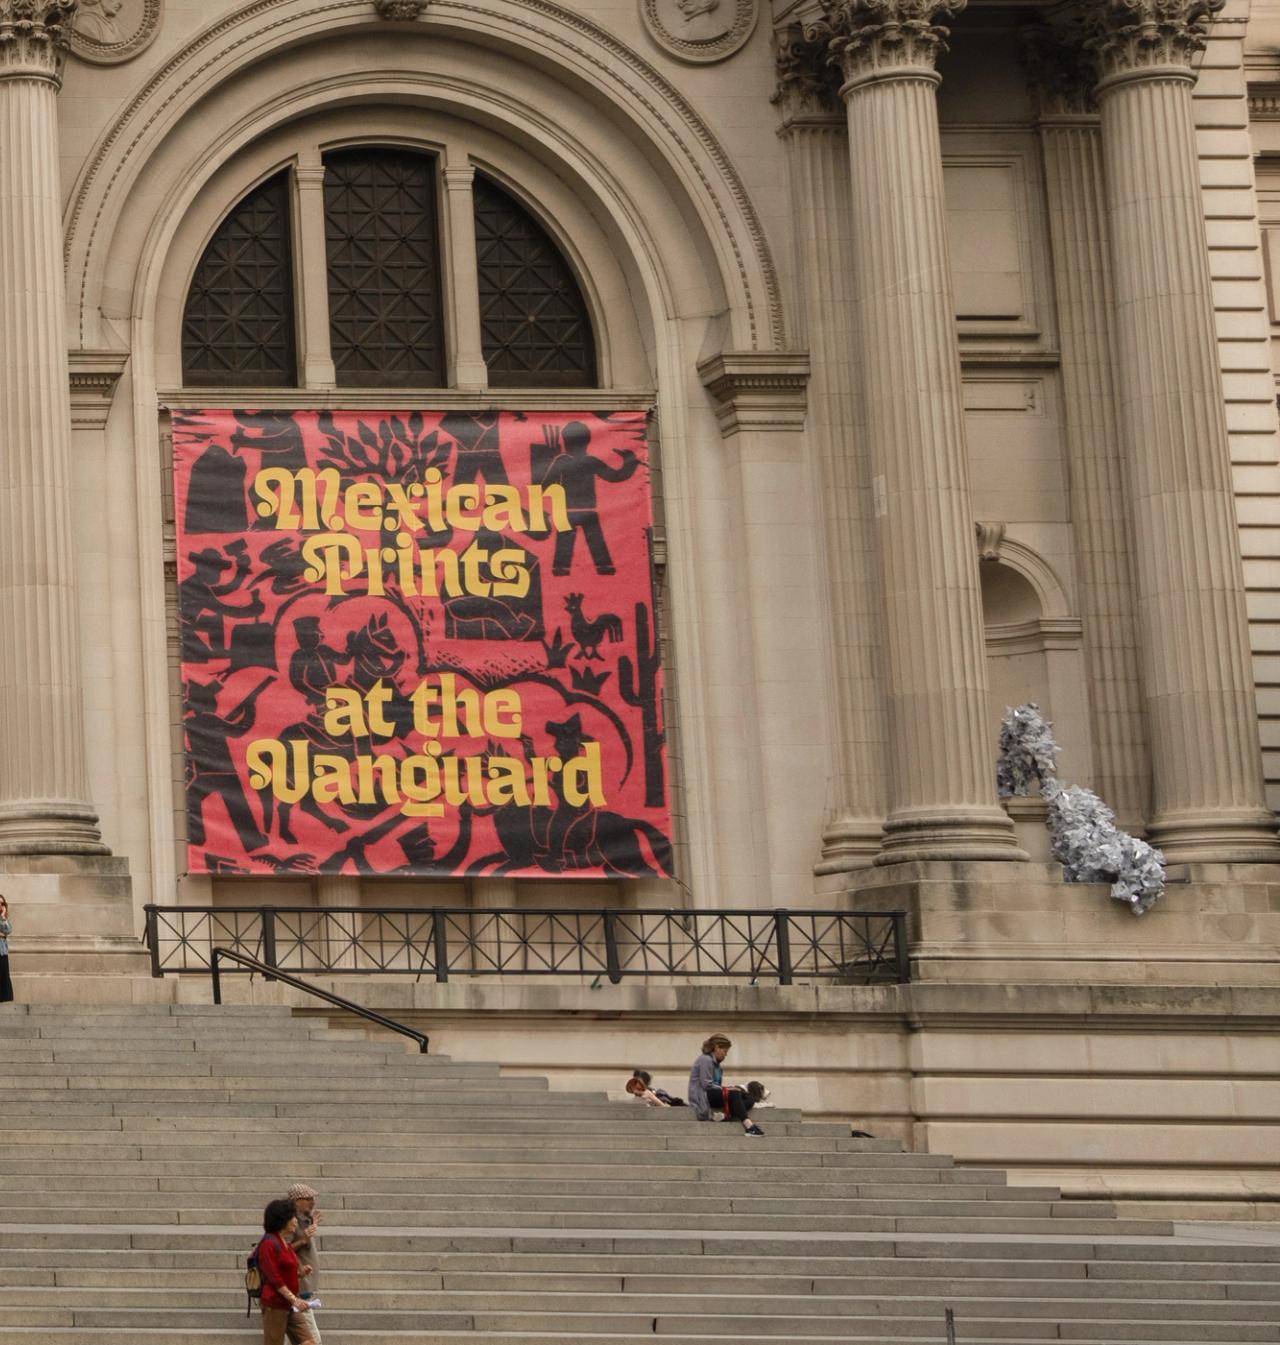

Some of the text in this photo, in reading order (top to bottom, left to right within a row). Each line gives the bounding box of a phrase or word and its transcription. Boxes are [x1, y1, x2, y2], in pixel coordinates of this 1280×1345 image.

[254, 467, 572, 533] Mexican
[302, 532, 532, 598] Prints
[323, 672, 523, 738] at the
[245, 738, 607, 817] Vanguard
